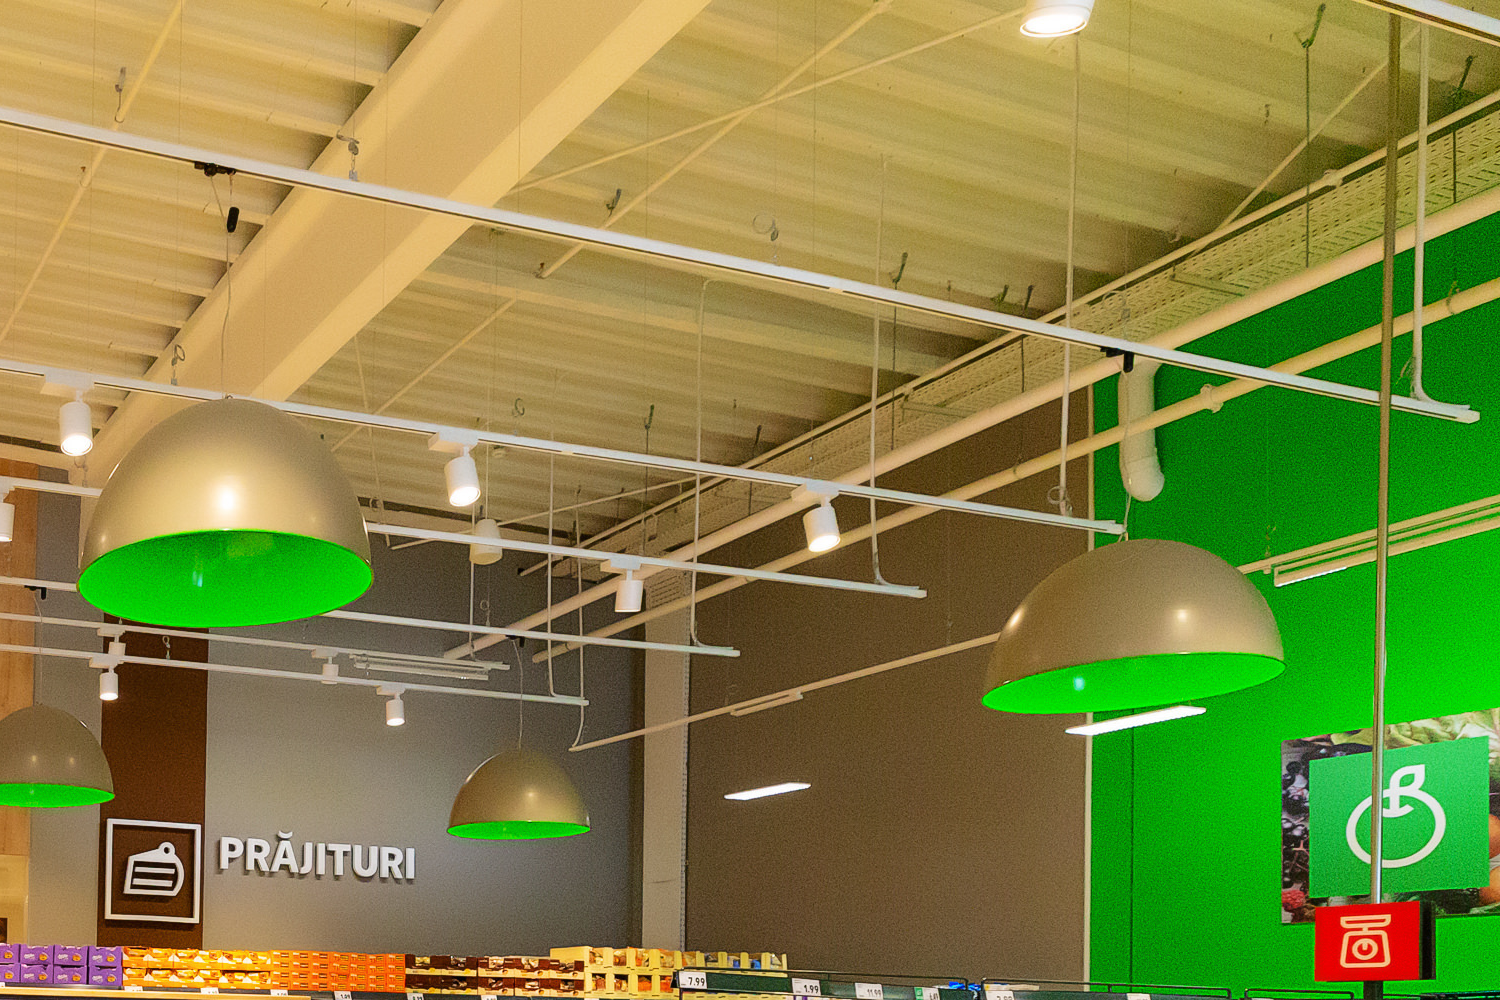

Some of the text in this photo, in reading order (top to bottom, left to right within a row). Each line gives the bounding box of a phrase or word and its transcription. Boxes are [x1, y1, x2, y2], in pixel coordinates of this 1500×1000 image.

[219, 829, 415, 879] PRĂJITURI
[688, 976, 705, 987] 7.99
[803, 984, 819, 994] 1.99
